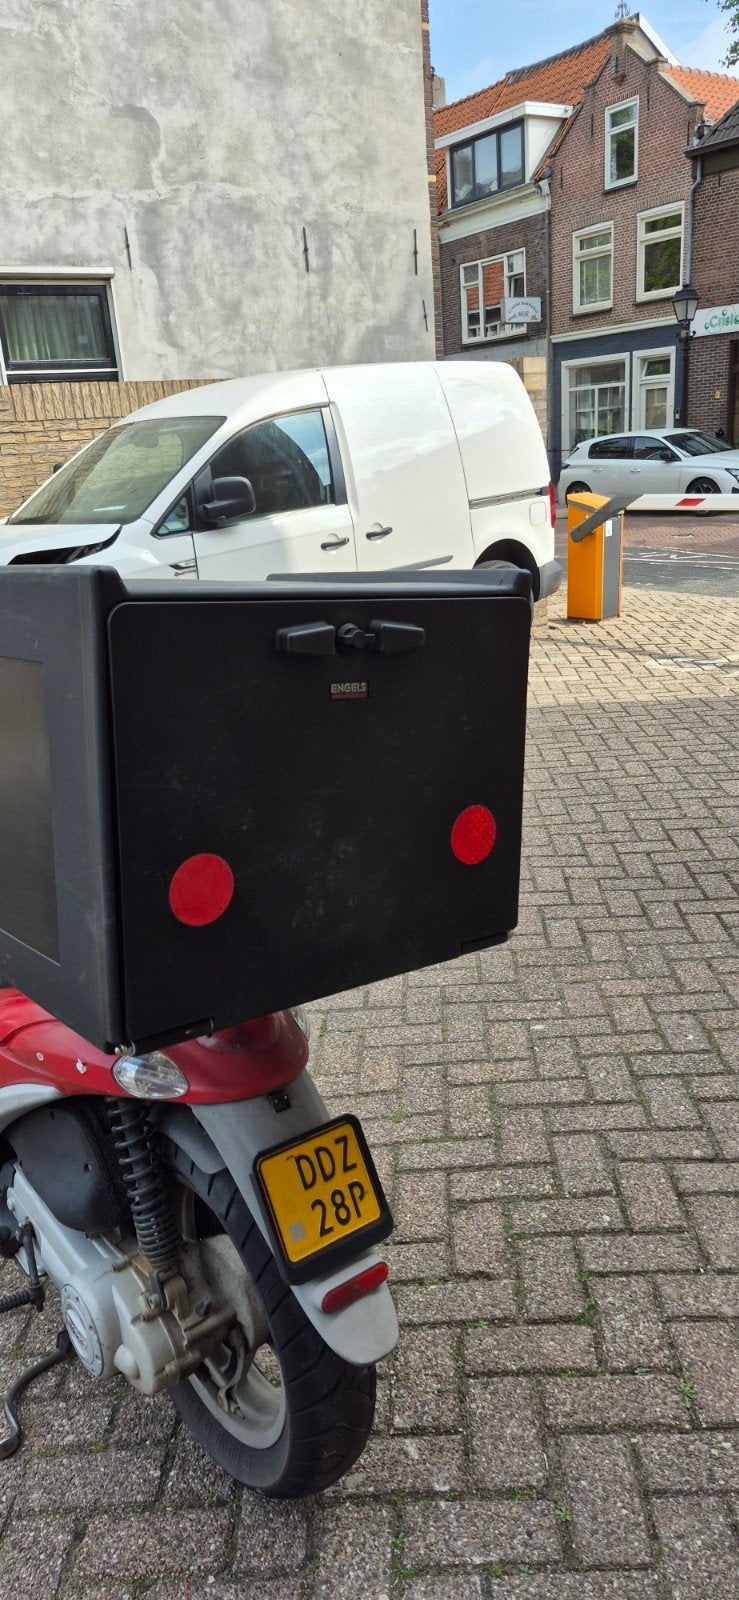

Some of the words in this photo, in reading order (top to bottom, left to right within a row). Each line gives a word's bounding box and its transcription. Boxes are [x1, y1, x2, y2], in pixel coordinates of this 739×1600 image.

[331, 682, 366, 694] ENGELS
[294, 1136, 357, 1191] DDZ
[311, 1180, 365, 1237] 28P
